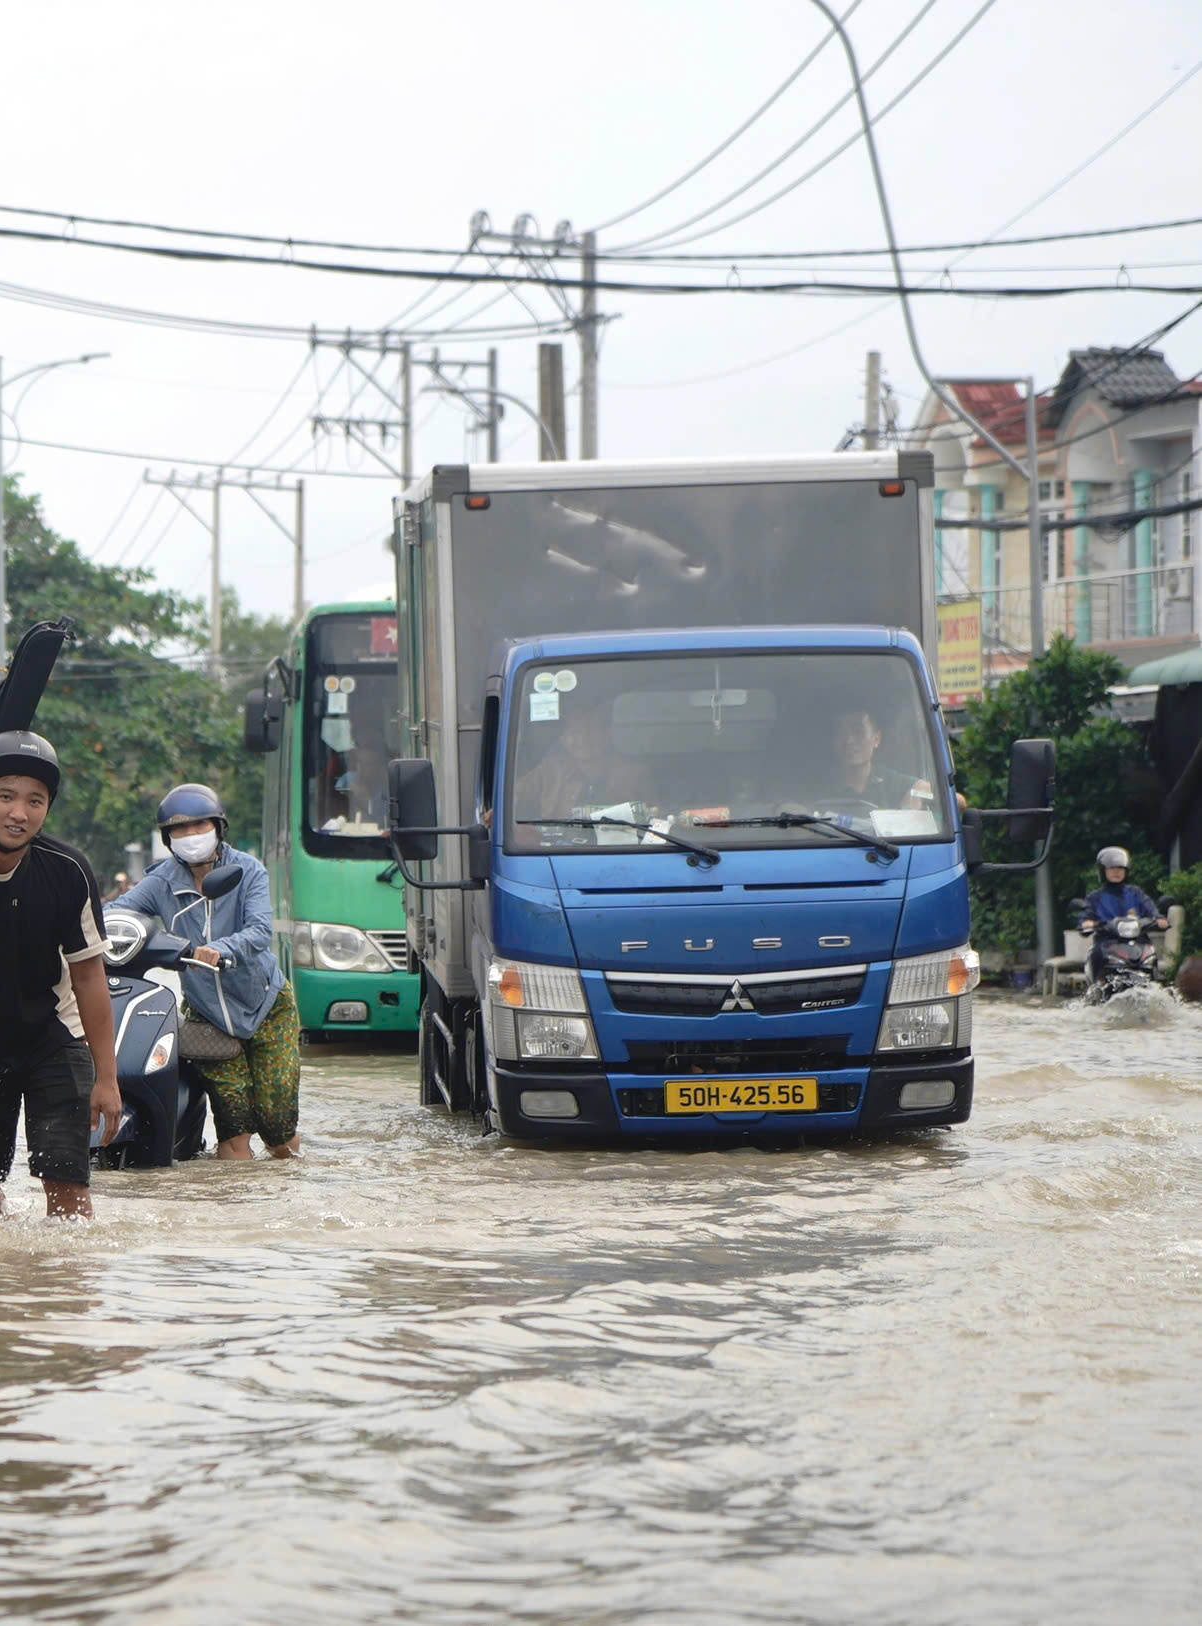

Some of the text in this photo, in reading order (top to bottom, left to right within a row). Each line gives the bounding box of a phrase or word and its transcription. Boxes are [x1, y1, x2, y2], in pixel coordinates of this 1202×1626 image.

[621, 935, 851, 953] FUSO
[801, 998, 845, 1009] CANTER
[679, 1085, 804, 1107] 50H-425.56
